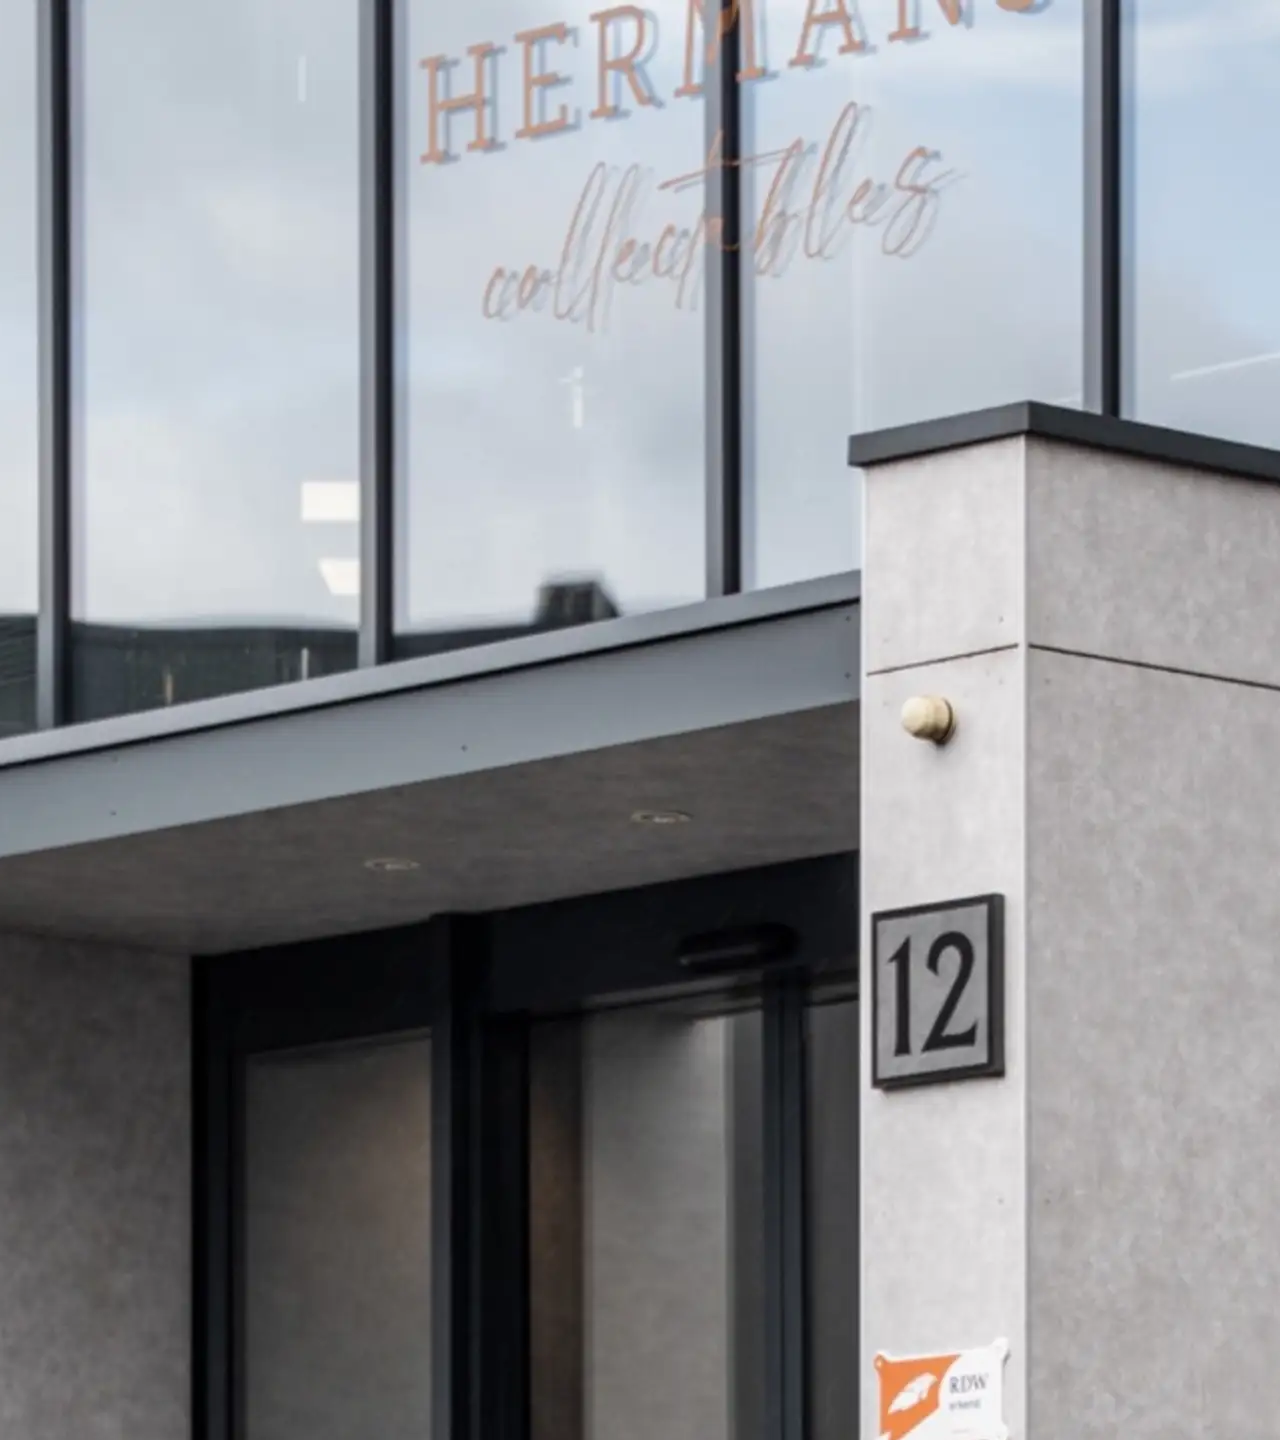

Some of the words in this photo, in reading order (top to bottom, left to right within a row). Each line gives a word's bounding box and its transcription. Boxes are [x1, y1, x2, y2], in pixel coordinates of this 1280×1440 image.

[419, 0, 1047, 164] HERMA
[887, 931, 978, 1057] 12
[949, 1373, 987, 1394] RDW
